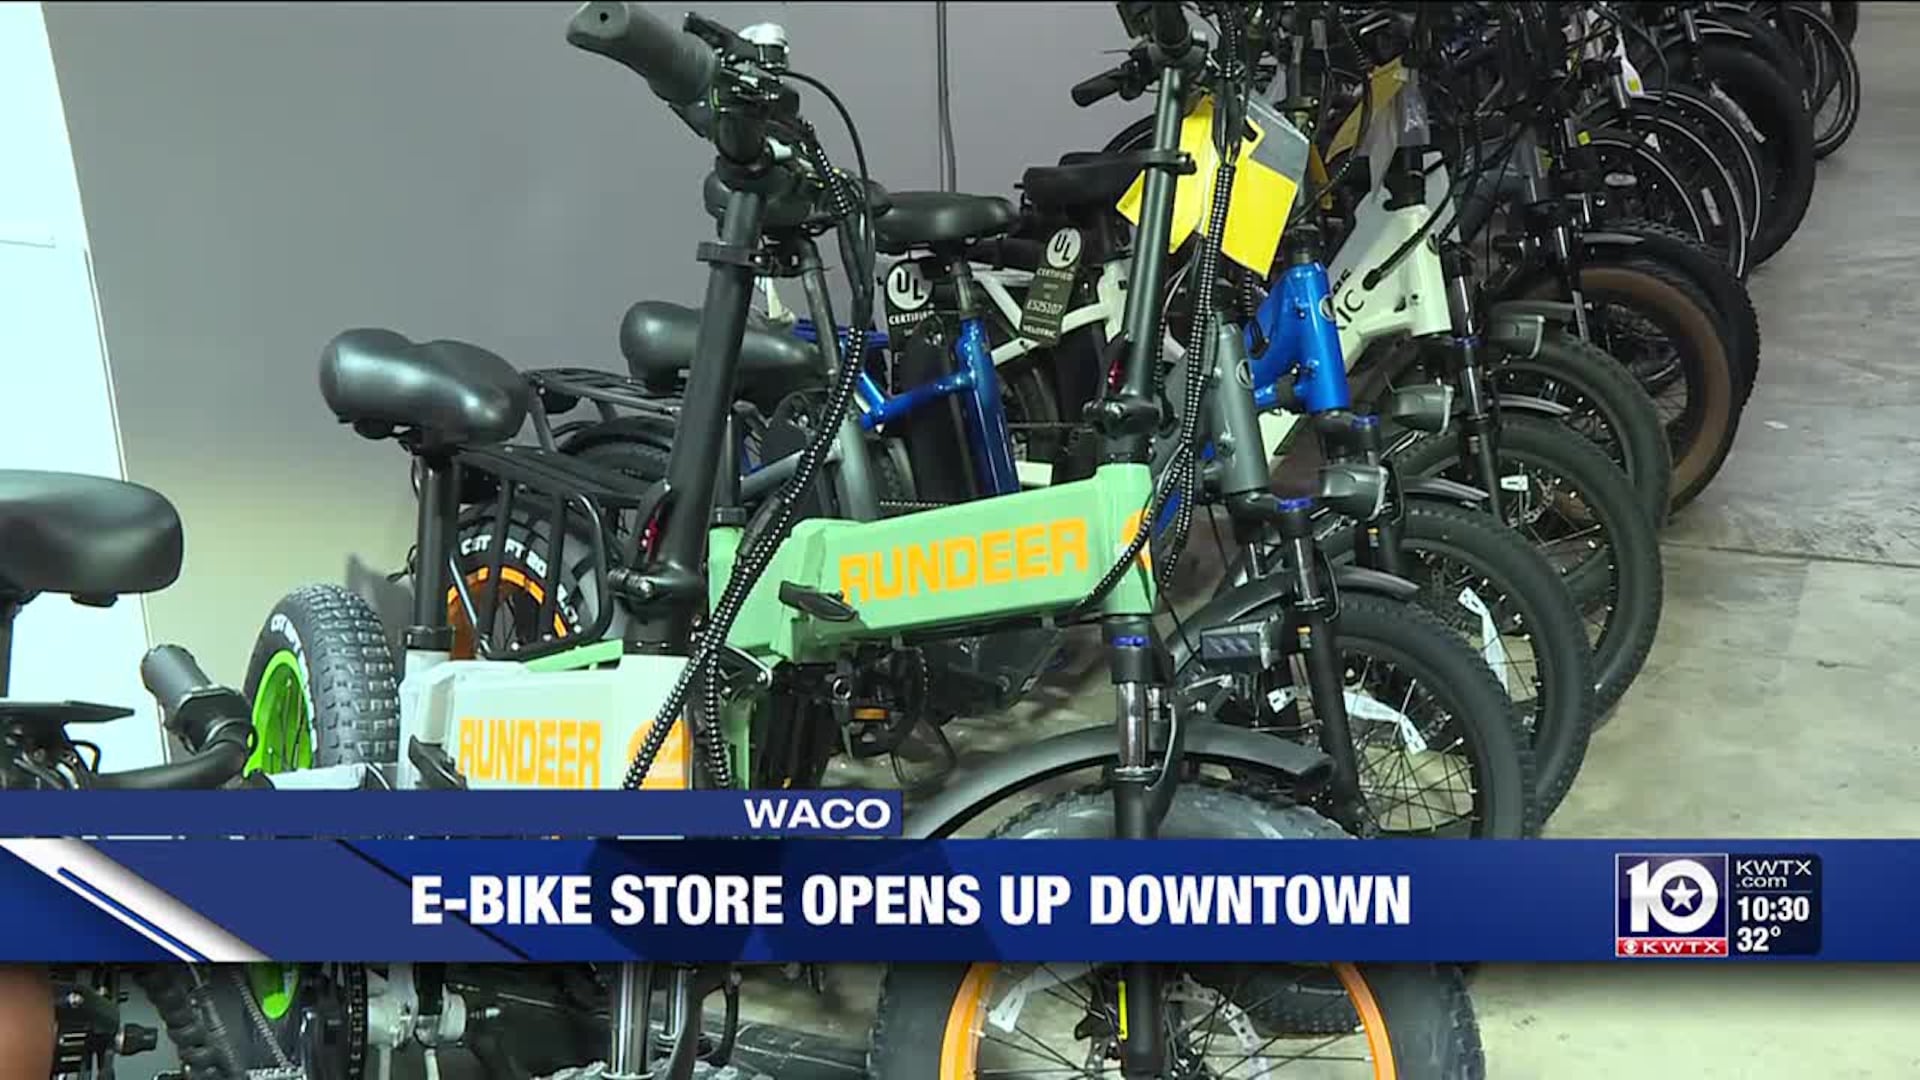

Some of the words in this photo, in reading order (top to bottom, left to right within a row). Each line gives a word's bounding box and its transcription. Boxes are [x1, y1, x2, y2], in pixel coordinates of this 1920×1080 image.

[1054, 233, 1072, 262] UL
[896, 271, 926, 300] UL
[1337, 288, 1365, 330] IC
[839, 516, 1089, 605] RUNDEER
[458, 719, 602, 790] RUNDEER
